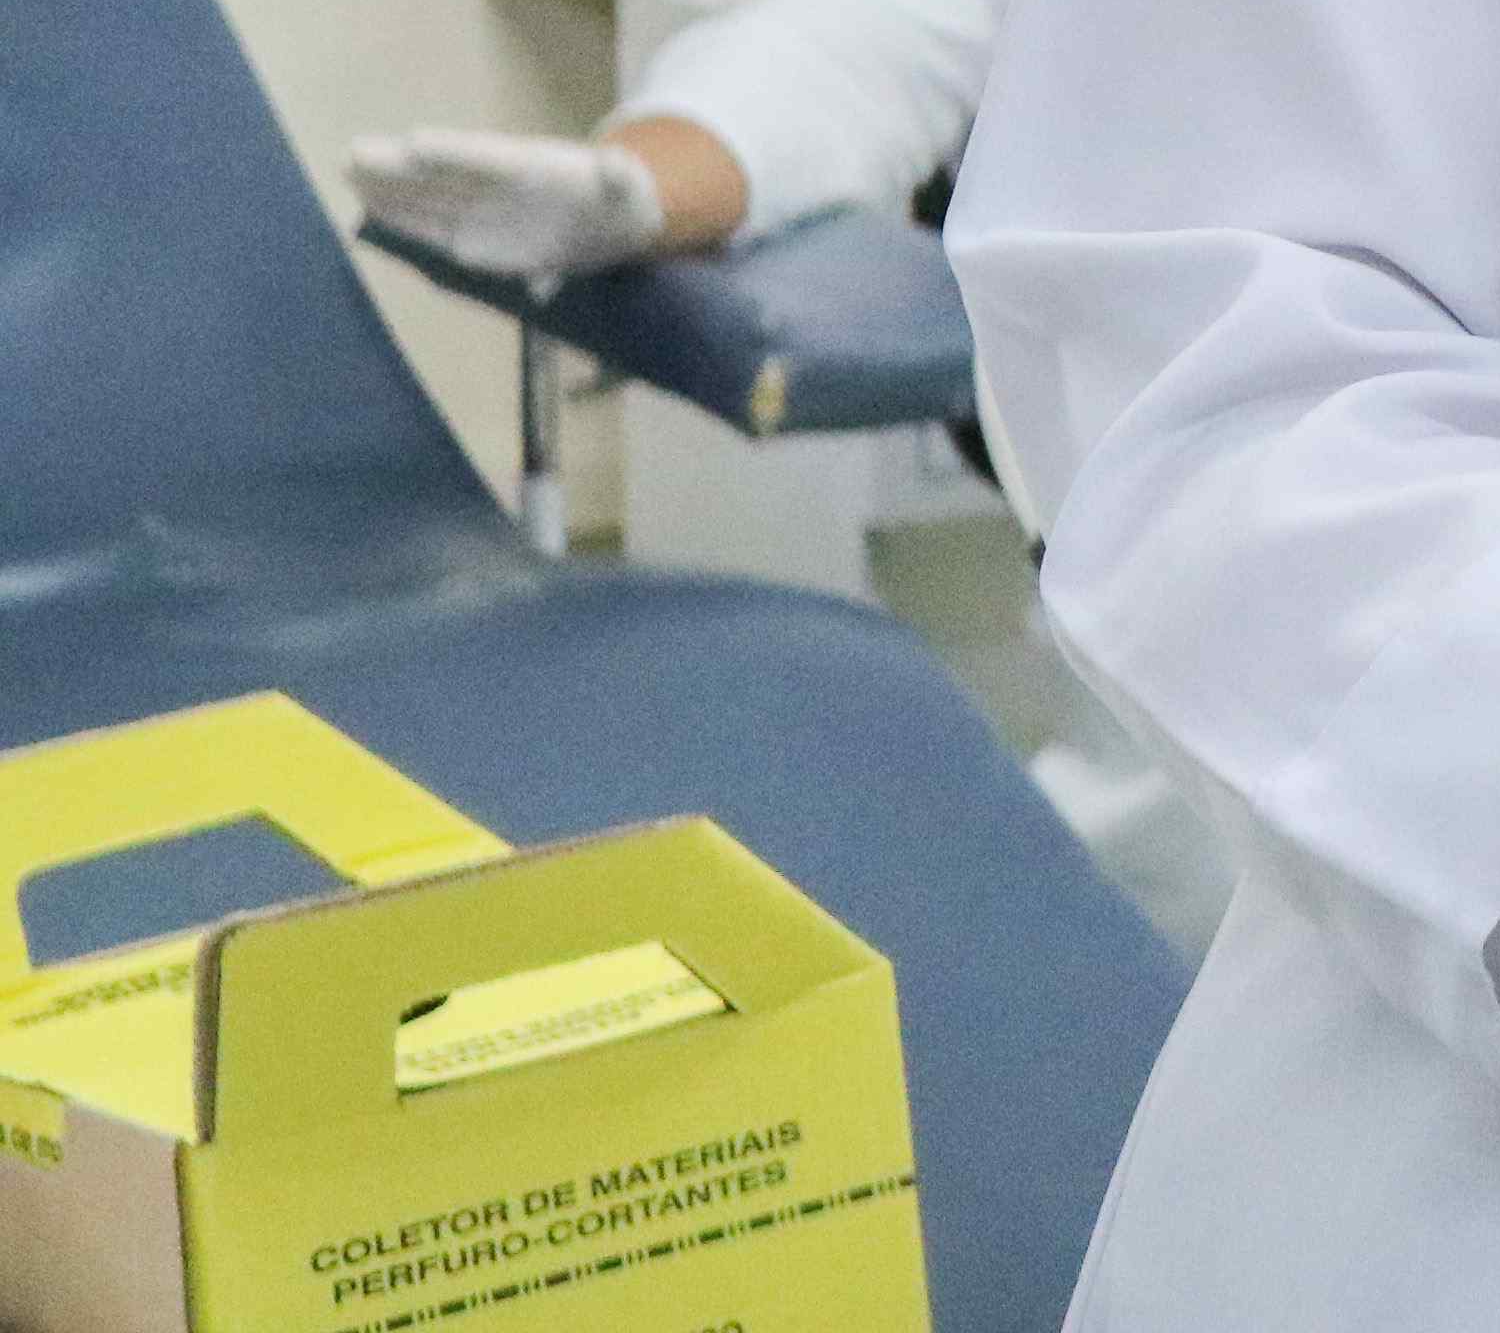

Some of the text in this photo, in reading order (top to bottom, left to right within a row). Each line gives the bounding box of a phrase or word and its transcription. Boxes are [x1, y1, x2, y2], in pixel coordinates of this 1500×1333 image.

[309, 1119, 801, 1273] COLETOR DE MATERIAIS
[333, 1157, 788, 1305] PERFURO-CORTANTES
